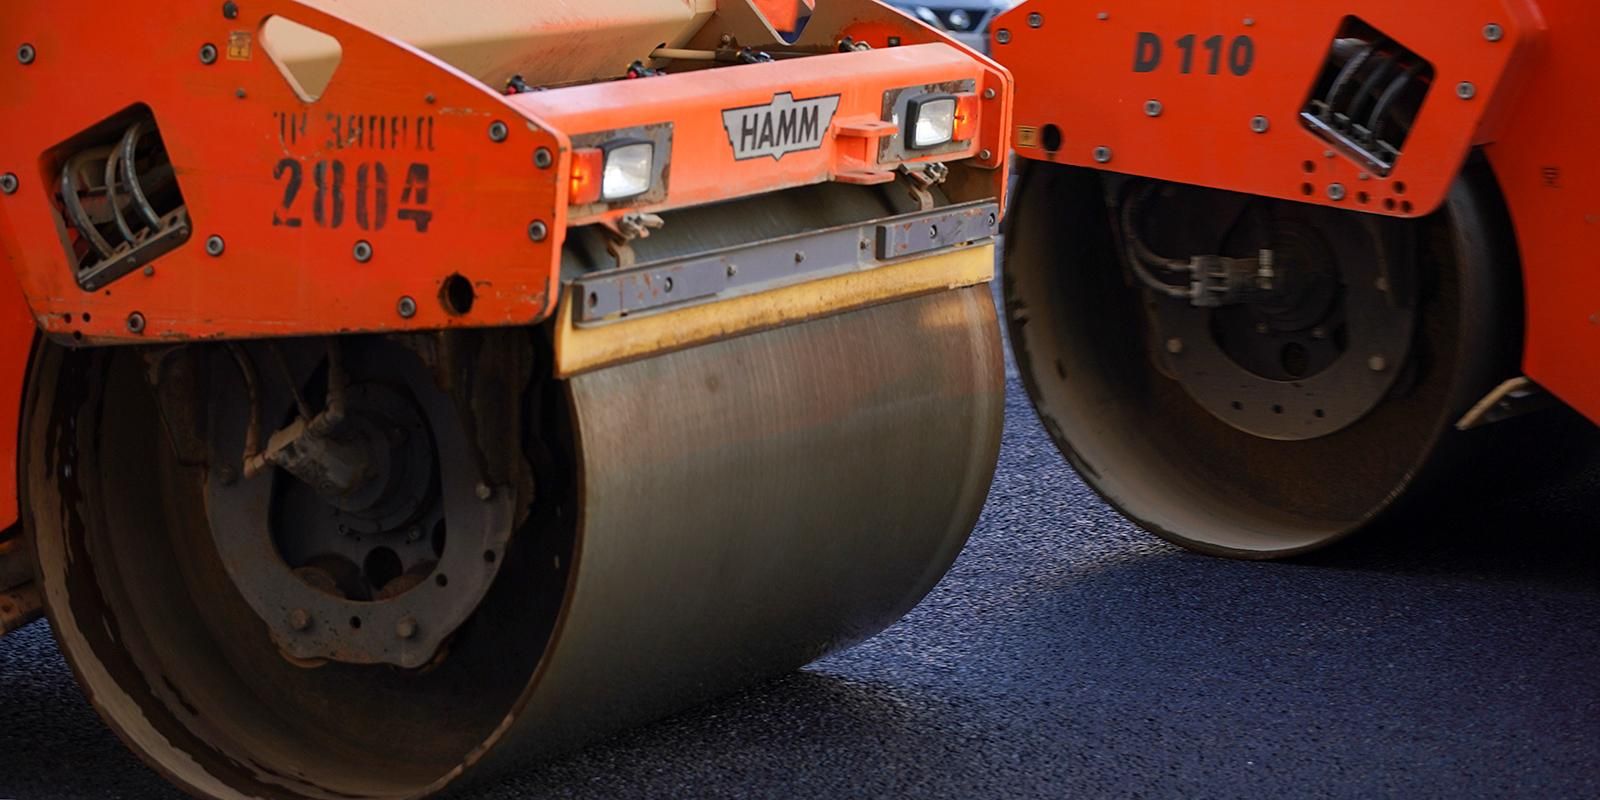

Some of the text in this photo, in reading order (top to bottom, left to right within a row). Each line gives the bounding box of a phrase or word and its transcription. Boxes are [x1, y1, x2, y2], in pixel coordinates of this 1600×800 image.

[1132, 31, 1254, 77] D 110
[740, 104, 819, 152] HAMM
[272, 157, 433, 233] 2804
